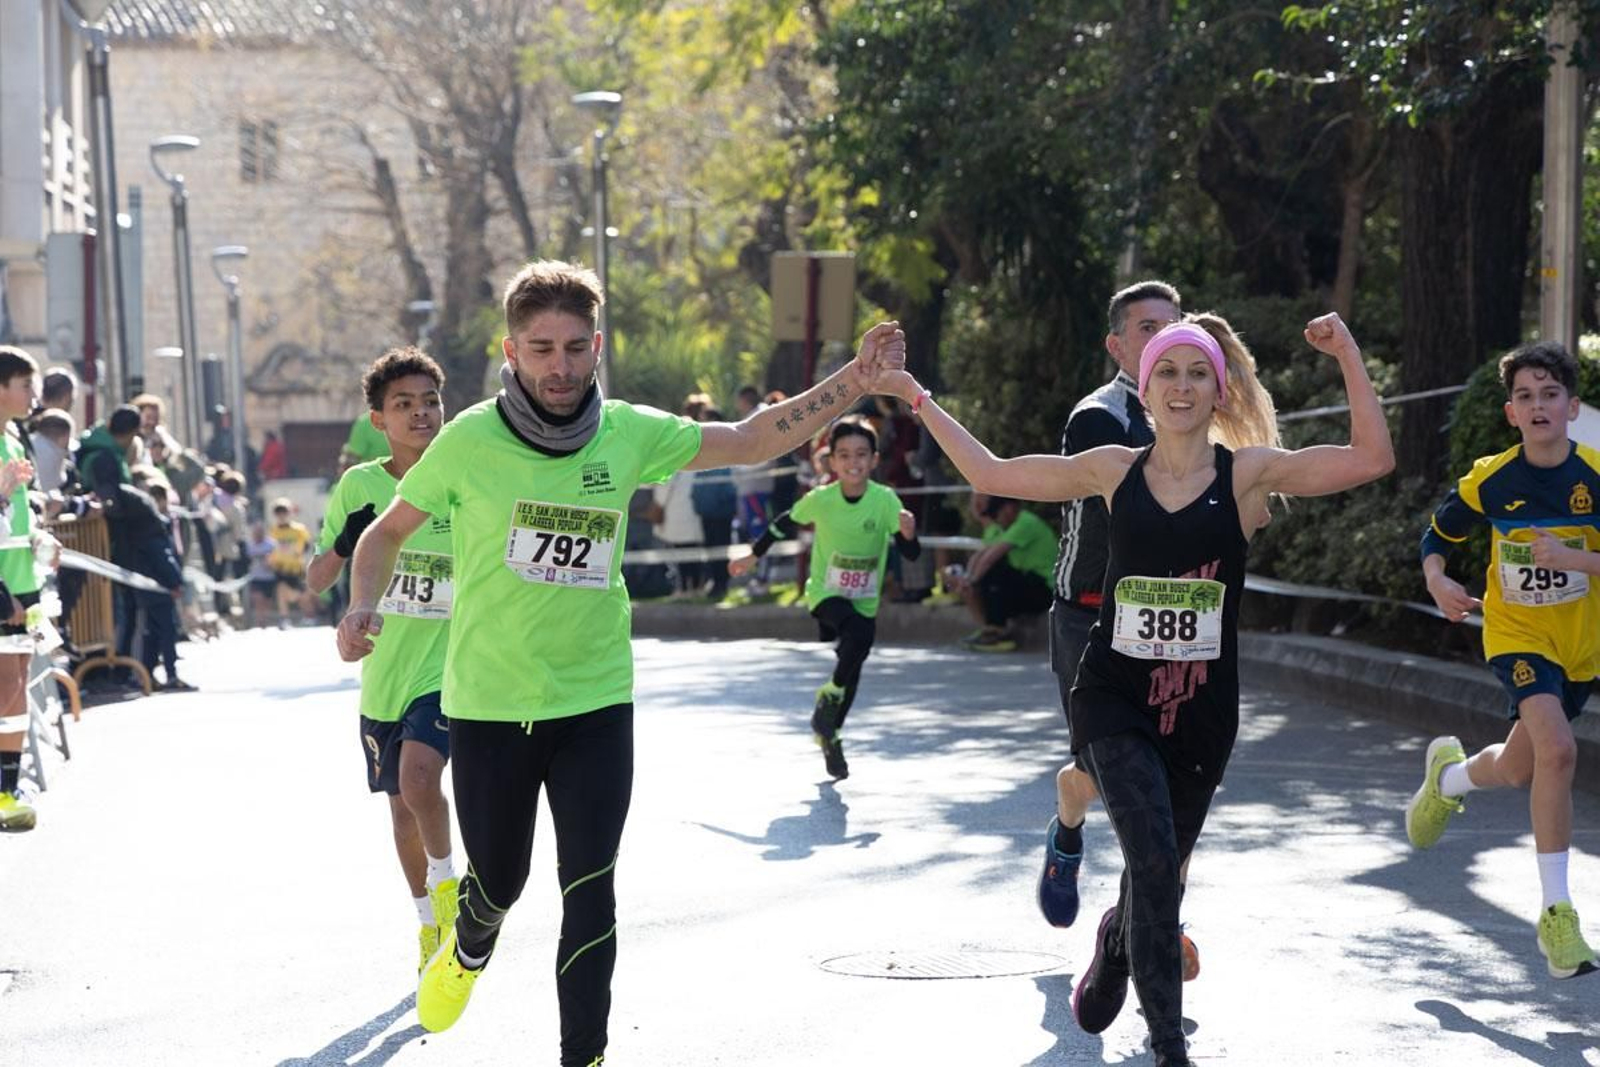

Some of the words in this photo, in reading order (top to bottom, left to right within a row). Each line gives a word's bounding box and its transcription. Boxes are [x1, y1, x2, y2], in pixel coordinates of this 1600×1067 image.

[536, 505, 549, 516] SAN
[550, 507, 568, 518] JUAN
[570, 510, 590, 521] BOSCO
[556, 519, 583, 531] POPULAR
[531, 532, 592, 569] 792
[386, 573, 434, 603] 743
[840, 571, 870, 588] 983
[1135, 581, 1147, 591] SAN
[1148, 582, 1167, 592] JUAN
[1518, 567, 1568, 591] 295
[1137, 608, 1198, 642] 388
